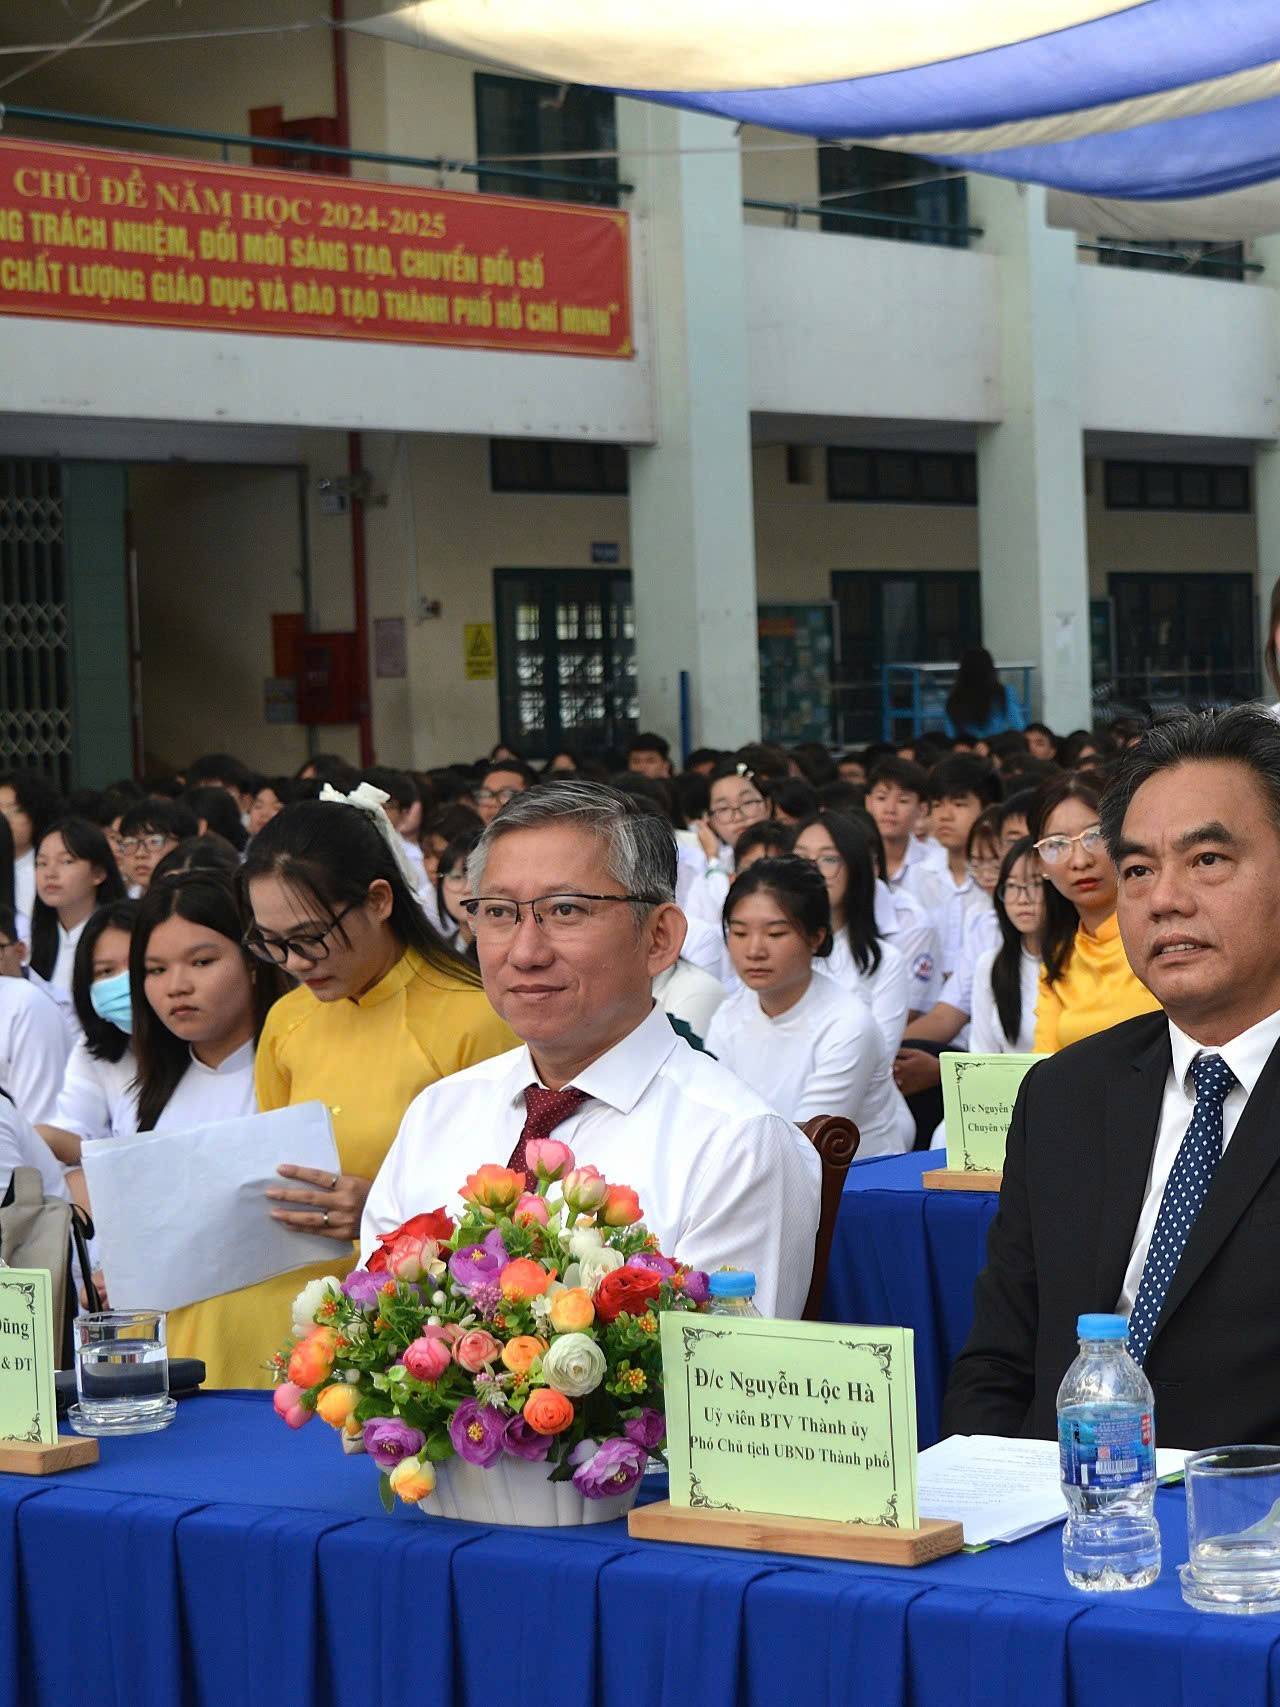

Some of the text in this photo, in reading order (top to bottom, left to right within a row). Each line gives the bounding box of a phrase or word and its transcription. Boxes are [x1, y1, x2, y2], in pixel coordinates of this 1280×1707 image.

[0, 1317, 30, 1341] ũng
[1, 1356, 11, 1370] &
[694, 1367, 875, 1404] Đ/c Nguyễn Lộc Hà
[727, 1409, 755, 1427] viên
[760, 1412, 794, 1430] BTV
[799, 1416, 846, 1436] Thành
[851, 1421, 868, 1441] ủy
[690, 1436, 890, 1469] Phó Chủ tịch UBND Thành phố
